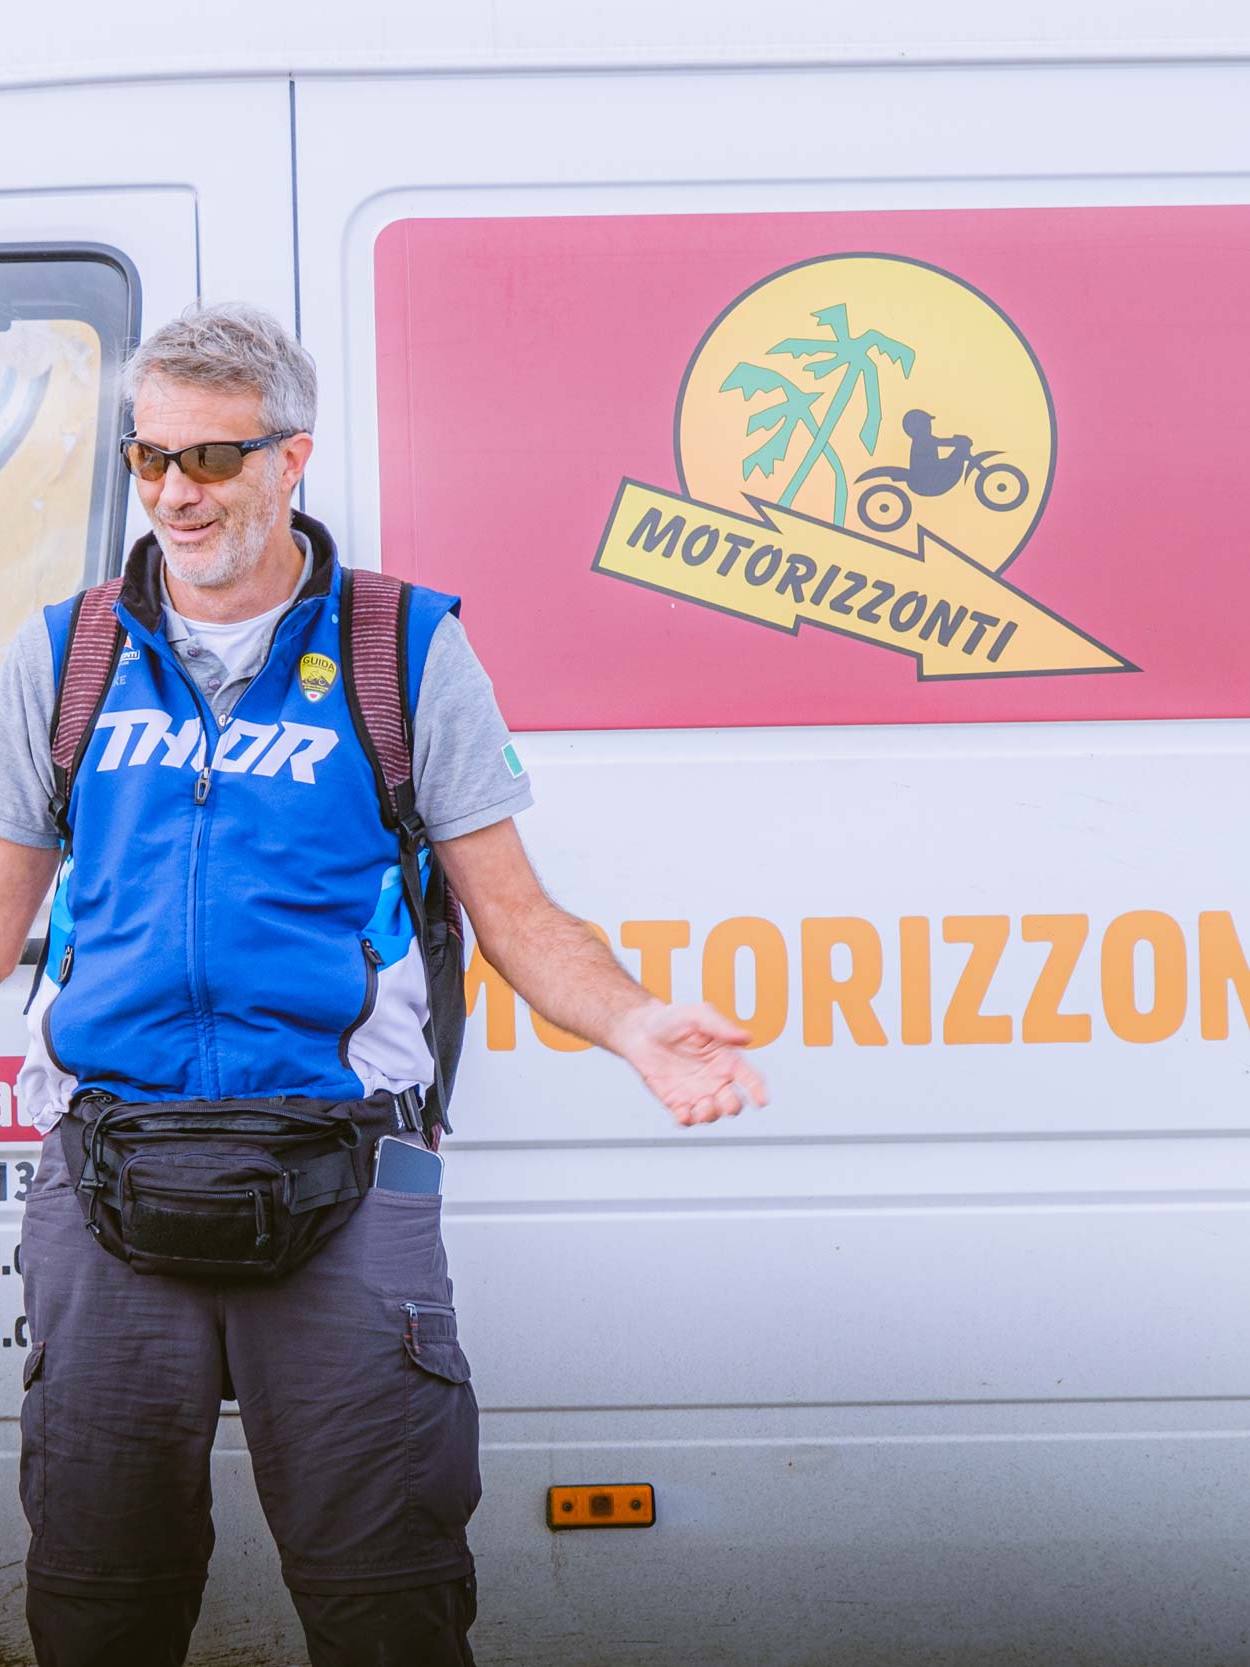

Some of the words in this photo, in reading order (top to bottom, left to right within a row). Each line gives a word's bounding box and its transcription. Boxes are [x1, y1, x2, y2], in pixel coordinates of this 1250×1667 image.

[626, 505, 1018, 663] MOTORIZZONTI
[302, 655, 335, 672] GUIDA
[95, 708, 340, 785] THOR
[464, 909, 1250, 1053] MTORIZZON
